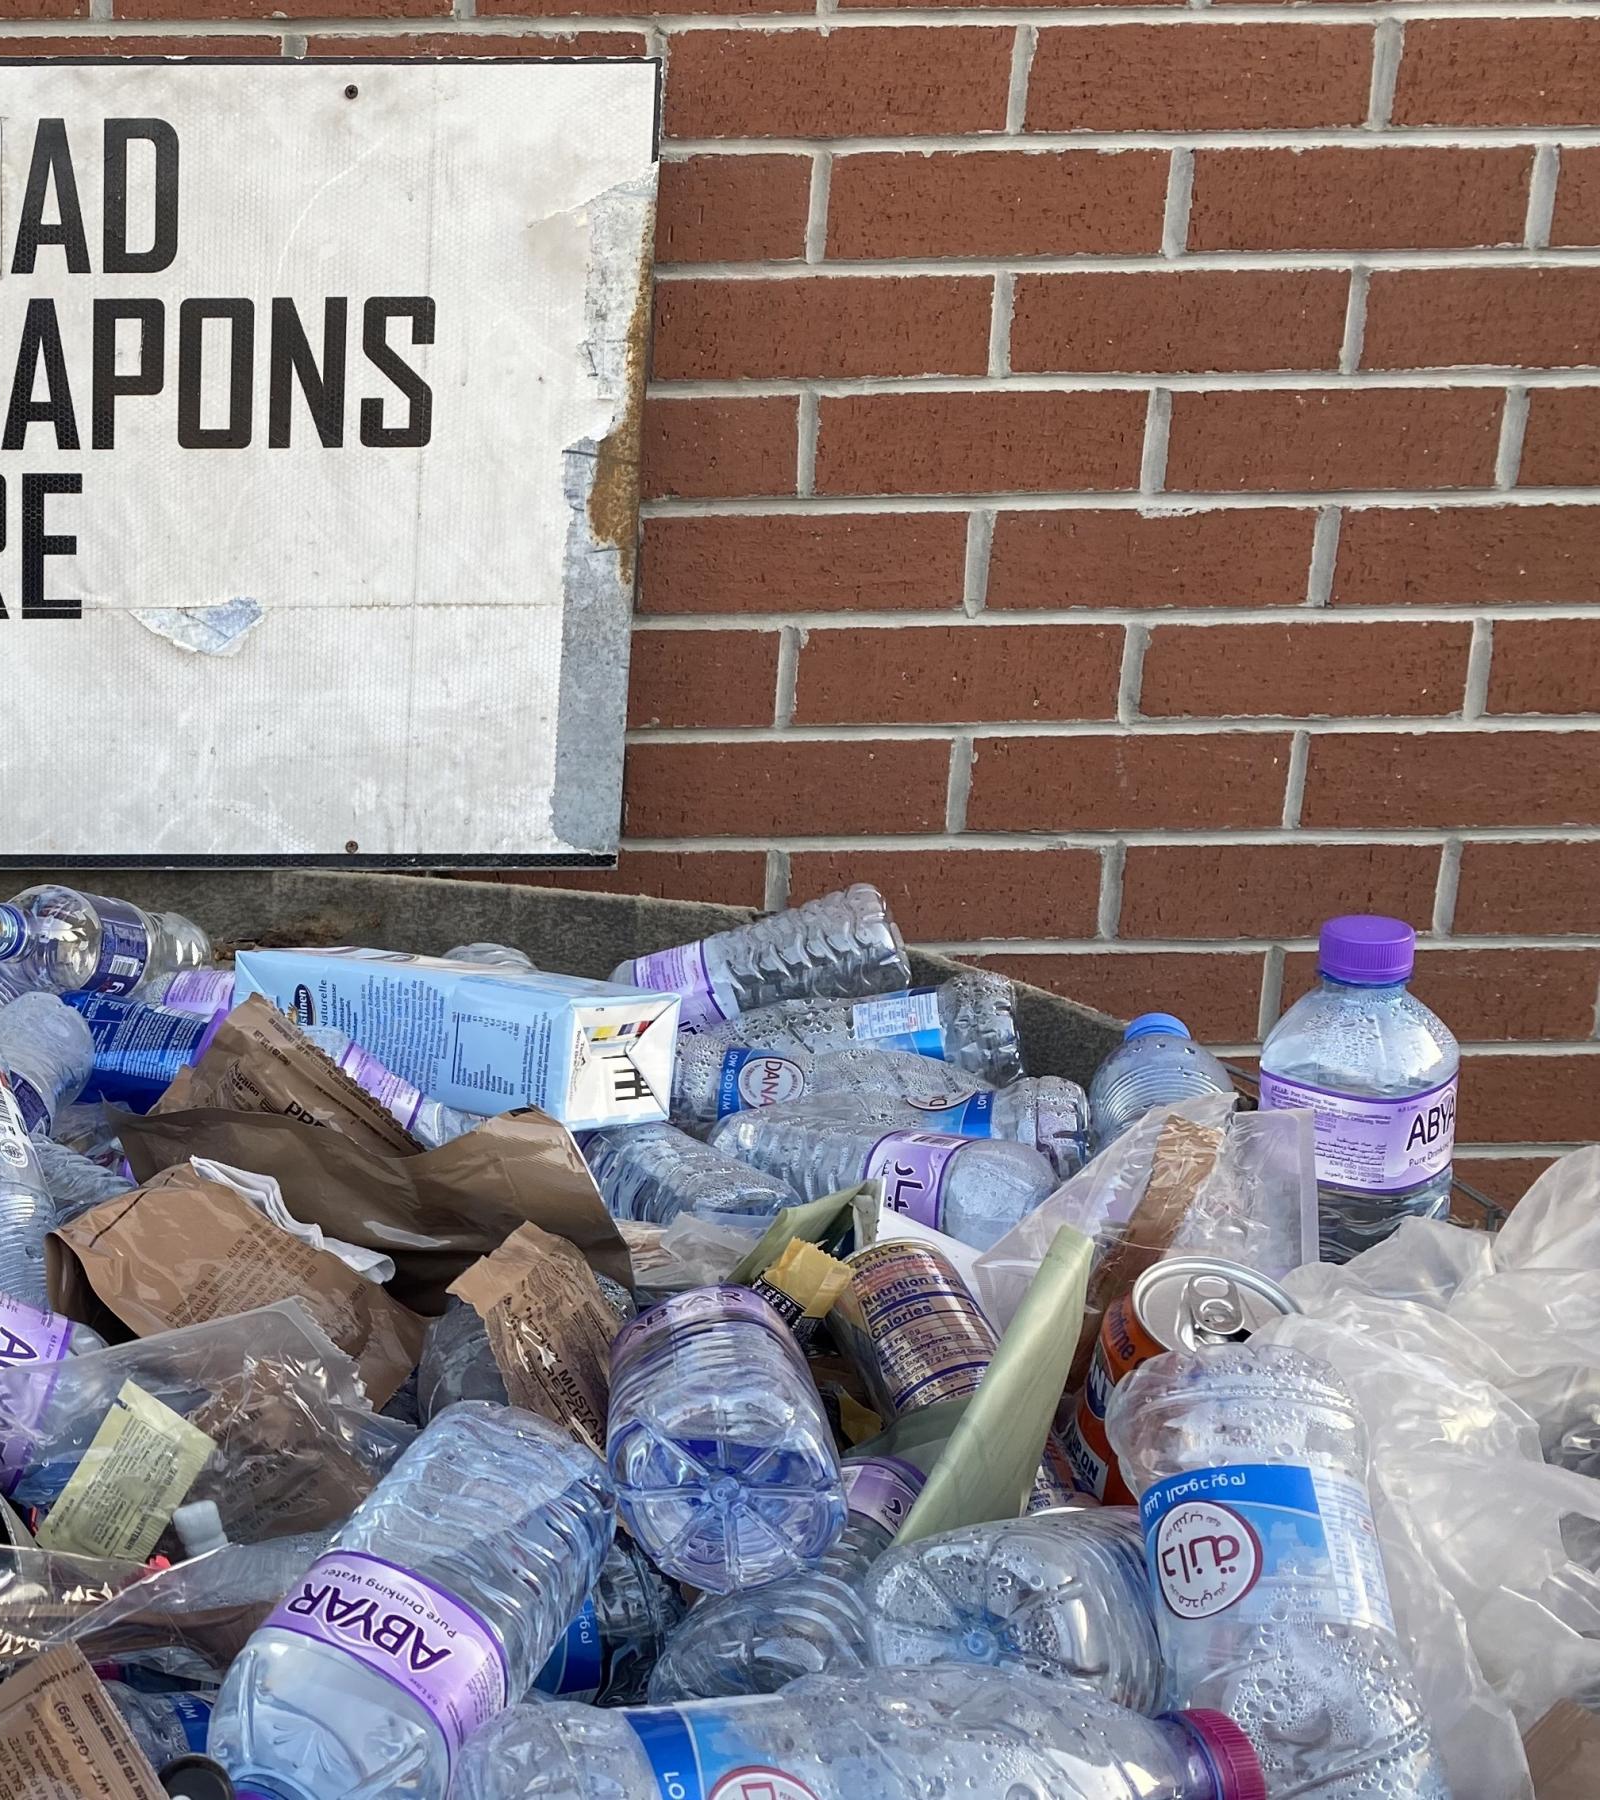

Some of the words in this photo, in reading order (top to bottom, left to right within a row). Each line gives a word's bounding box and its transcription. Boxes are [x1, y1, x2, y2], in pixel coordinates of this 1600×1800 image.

[722, 1071, 736, 1110] SODIUM
[759, 1060, 783, 1107] DANA
[1408, 1157, 1426, 1168] Pure
[862, 1273, 928, 1309] Nutrition
[897, 1287, 918, 1298] size
[870, 1303, 932, 1340] Calories
[894, 1333, 907, 1344] Fat
[898, 1334, 952, 1362] Carbohydrate
[1144, 1491, 1161, 1515] قليل
[1166, 1472, 1246, 1501] الصوديوم
[1160, 1534, 1239, 1583] دانة
[321, 1567, 361, 1583] Water
[365, 1576, 424, 1613] Drinking
[287, 1582, 450, 1671] ABYAR
[425, 1611, 456, 1637] Pure
[33, 1715, 56, 1746] peanut
[51, 1698, 81, 1736] (28g)
[22, 1727, 39, 1747] soy
[71, 1734, 91, 1758] OZ
[47, 1742, 72, 1775] regular
[5, 1763, 27, 1792] SALT,
[63, 1772, 77, 1788] in
